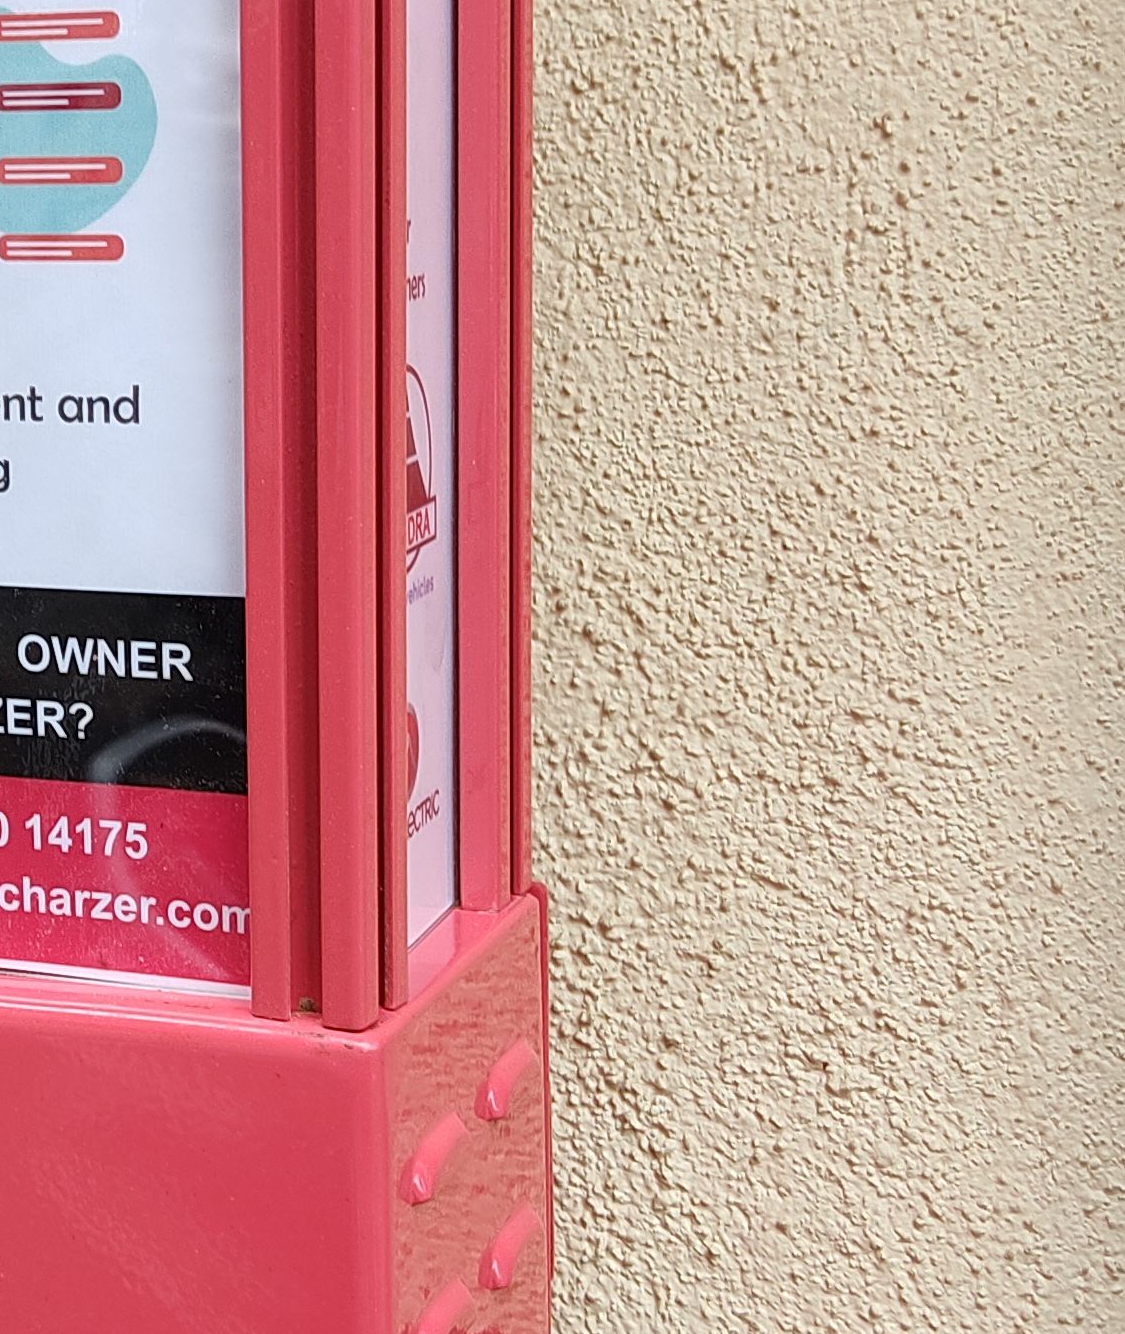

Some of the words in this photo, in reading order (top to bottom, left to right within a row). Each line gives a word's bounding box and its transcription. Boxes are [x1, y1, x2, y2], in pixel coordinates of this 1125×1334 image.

[57, 386, 140, 425] and
[17, 634, 193, 682] OWNER
[24, 814, 148, 860] 14175
